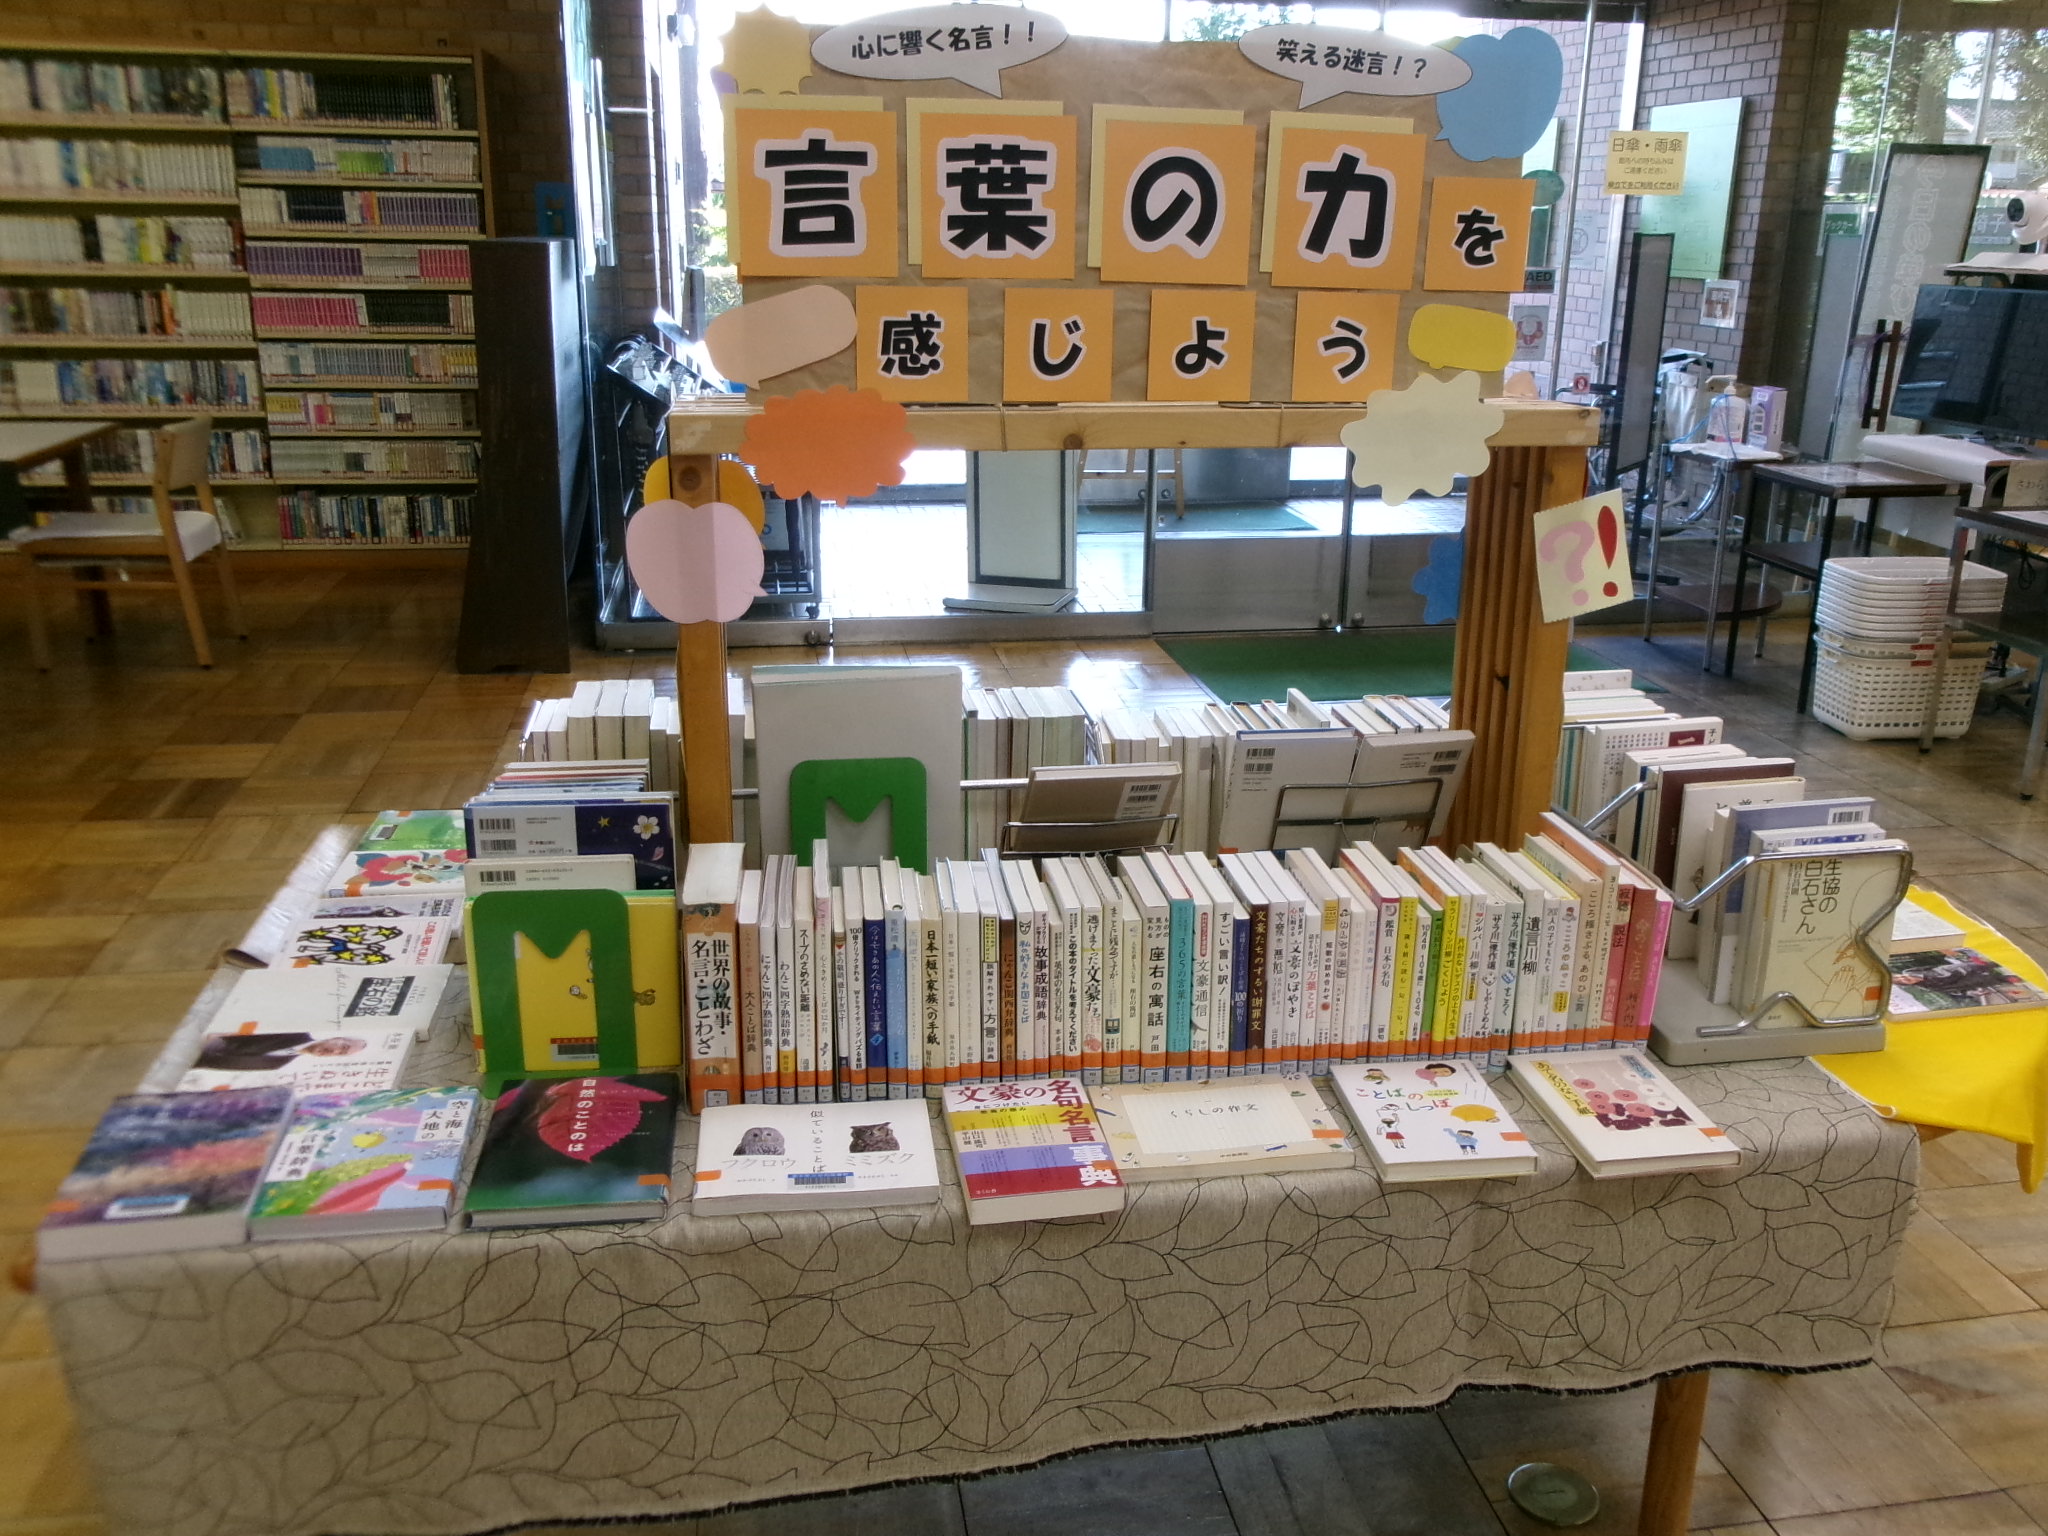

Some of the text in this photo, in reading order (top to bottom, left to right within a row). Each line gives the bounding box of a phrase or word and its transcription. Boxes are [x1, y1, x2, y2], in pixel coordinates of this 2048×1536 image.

[1612, 138, 1683, 153] 日傘・雨傘
[761, 137, 1505, 267] 言葉の力を
[879, 311, 1367, 382] 感じよう
[1795, 860, 1824, 935] 白石さん
[1819, 858, 1843, 914] 生協の
[1381, 945, 1394, 988] 日本の名句
[1521, 917, 1541, 976] 遺言川柳
[691, 939, 715, 1056] 名言・ことわざ
[761, 955, 773, 1048] にゃんこ四字熟語辞典
[779, 962, 791, 1048] わんこ四字熟語辞典
[1034, 948, 1049, 1021] 故事成語辞典
[1147, 946, 1166, 1027] 座右の寓話
[1194, 959, 1210, 1018] 文豪通信
[951, 1084, 1047, 1105] 文豪の
[1170, 1103, 1259, 1118] くらしの作文
[1355, 1087, 1424, 1100] ことばの
[1405, 1098, 1453, 1112] しっぽ
[721, 1157, 797, 1169] フクロウ
[810, 1110, 826, 1172] 似ていることば
[845, 1152, 915, 1167] ミミズク
